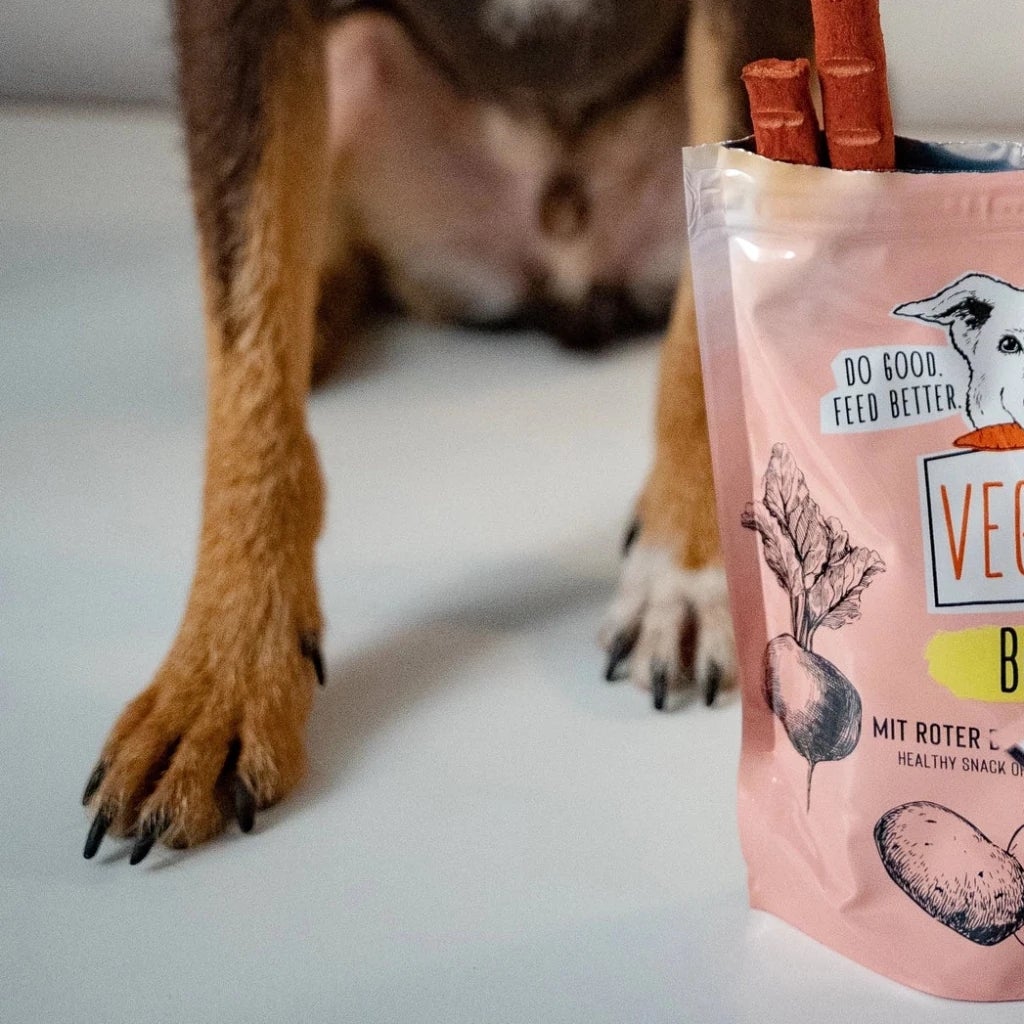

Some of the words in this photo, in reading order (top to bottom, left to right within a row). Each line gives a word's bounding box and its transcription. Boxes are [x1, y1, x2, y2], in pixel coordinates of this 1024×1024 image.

[845, 356, 872, 387] DO
[884, 350, 943, 381] GOOD.
[833, 394, 879, 426] FEED
[891, 383, 962, 419] BETTER.
[873, 716, 907, 742] MIT
[916, 721, 981, 750] ROTER
[898, 750, 957, 770] HEALTHY
[962, 757, 1006, 775] SNACK
